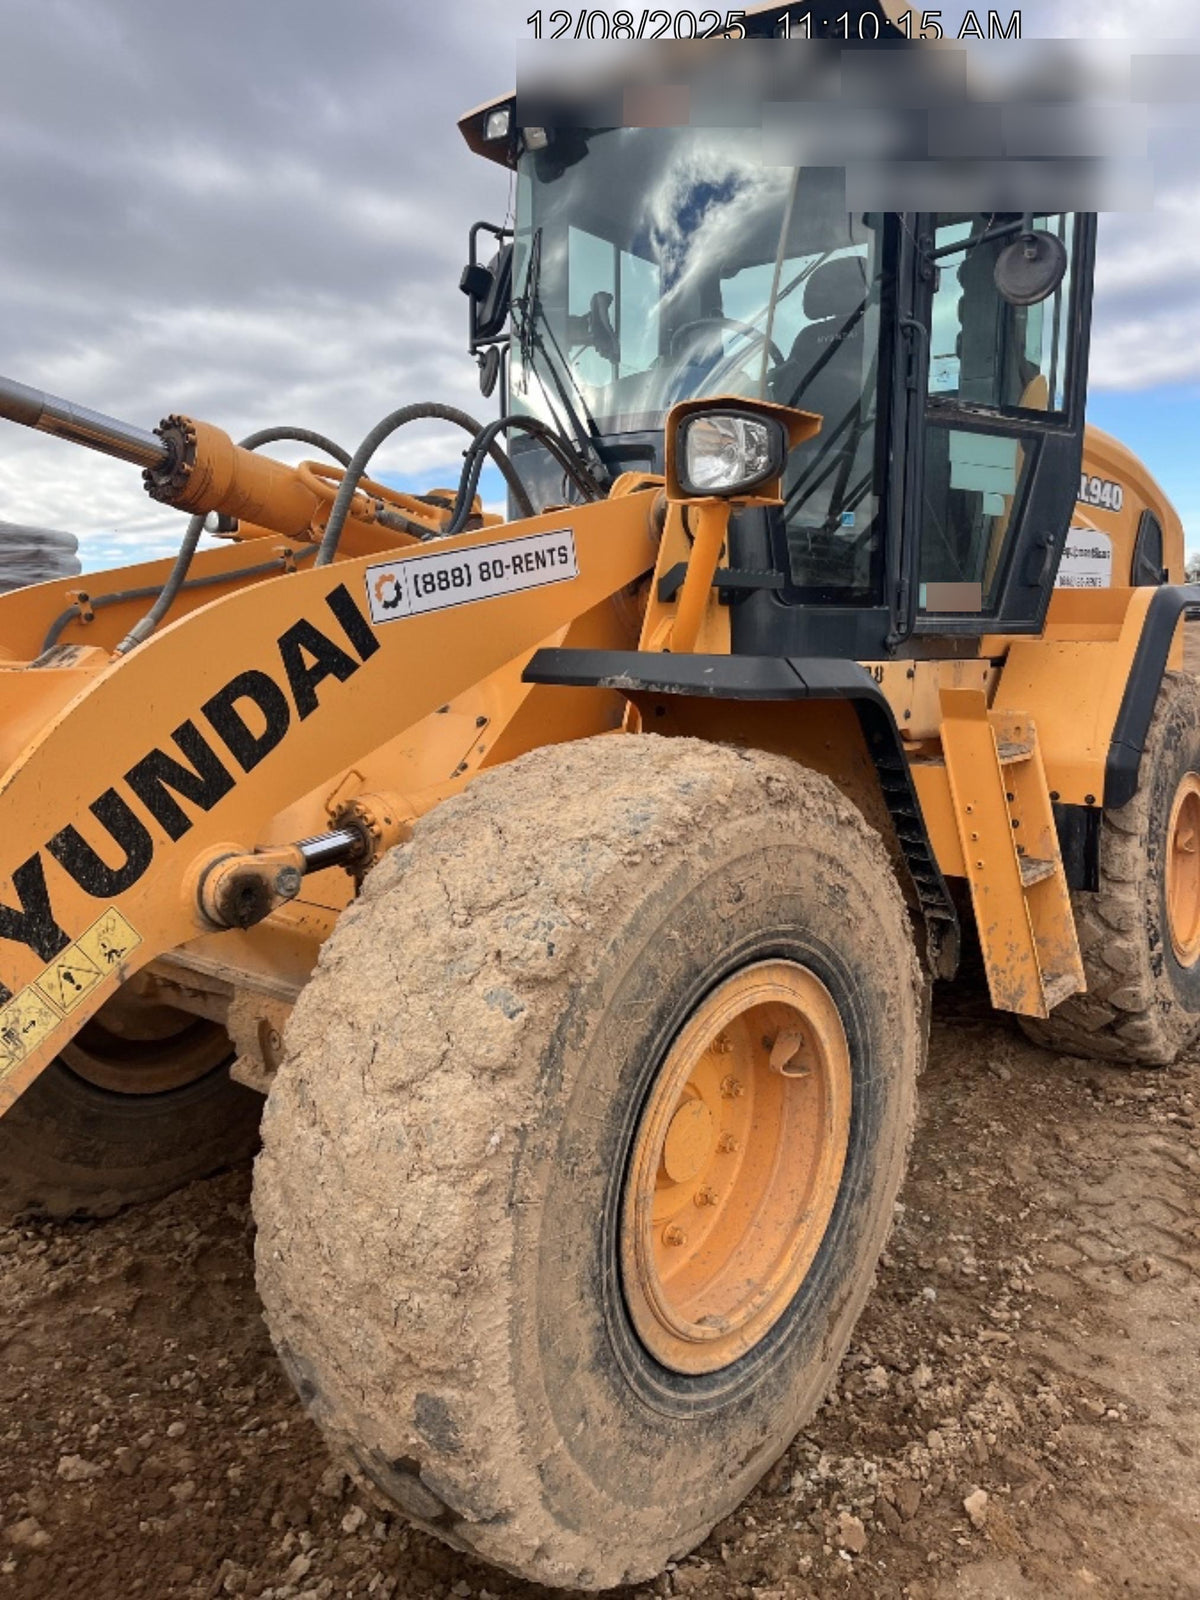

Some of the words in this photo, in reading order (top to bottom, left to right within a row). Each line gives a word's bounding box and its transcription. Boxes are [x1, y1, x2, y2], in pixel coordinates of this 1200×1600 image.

[1077, 473, 1124, 512] L940
[413, 563, 472, 598] (888)
[479, 545, 568, 582] 80-RENTS
[0, 583, 381, 1005] YUNDAI
